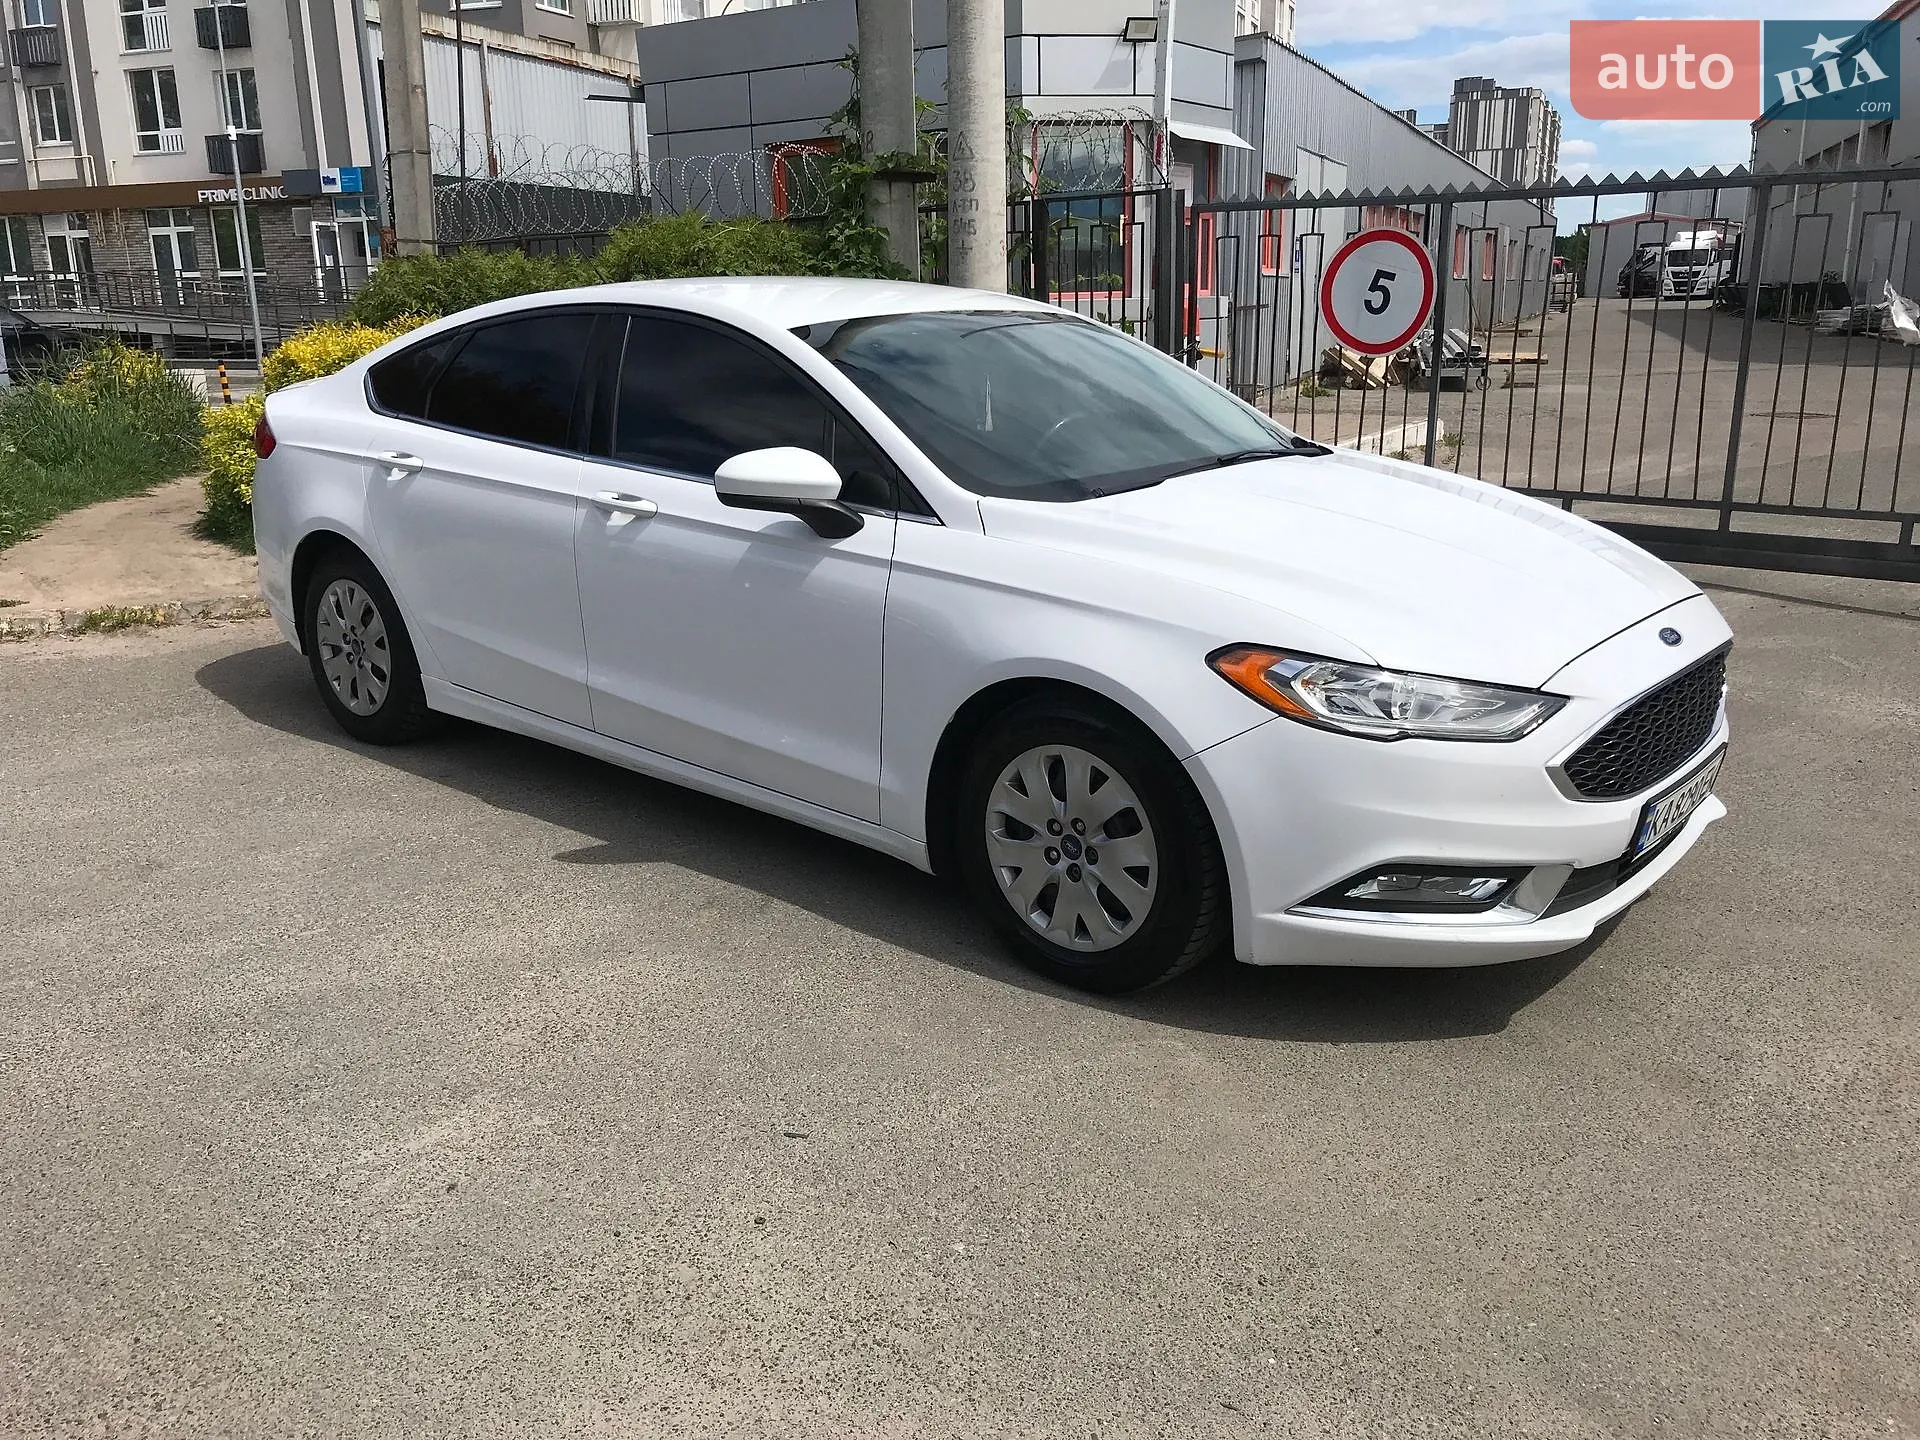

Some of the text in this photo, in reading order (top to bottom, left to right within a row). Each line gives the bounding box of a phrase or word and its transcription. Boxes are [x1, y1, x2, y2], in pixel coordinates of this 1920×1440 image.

[241, 185, 289, 201] CLINIC
[1363, 268, 1397, 316] 5
[1647, 799, 1675, 842] KA
